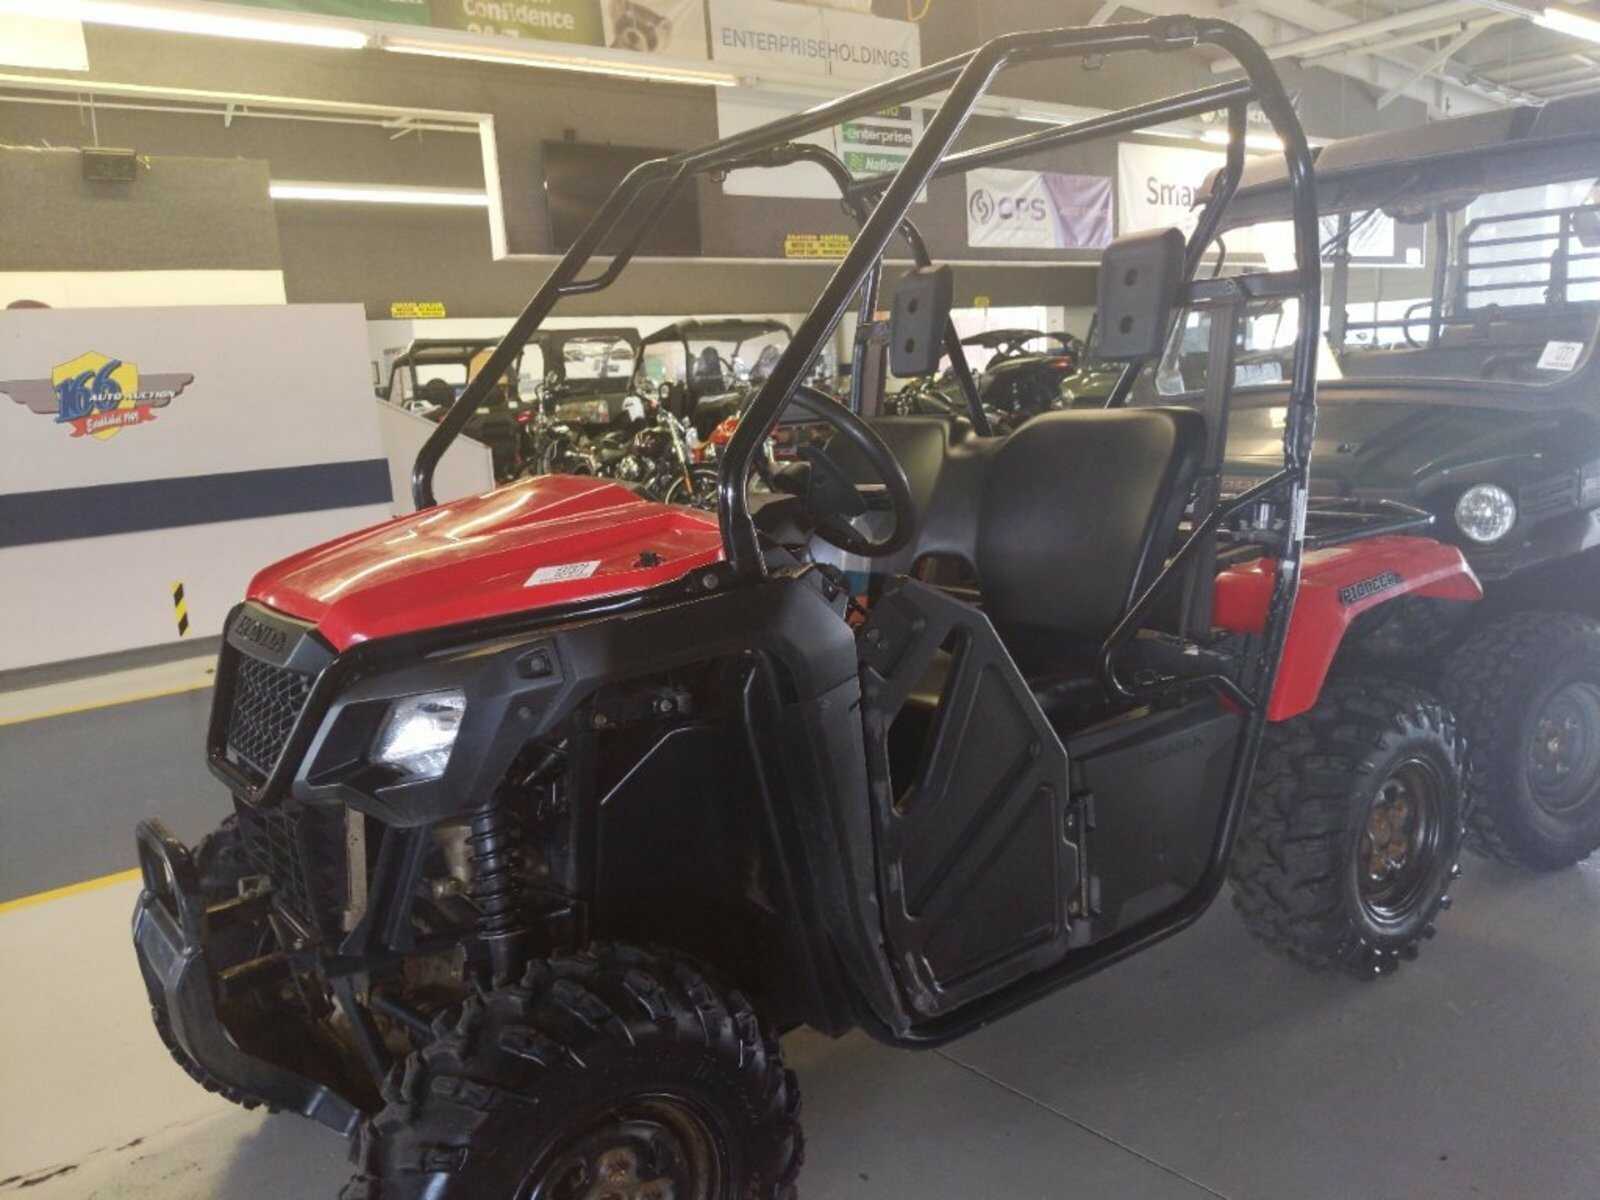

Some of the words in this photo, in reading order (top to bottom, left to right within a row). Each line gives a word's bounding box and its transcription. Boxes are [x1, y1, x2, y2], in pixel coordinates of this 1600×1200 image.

[462, 0, 576, 30] Confidence
[55, 359, 122, 424] 166
[89, 390, 122, 402] AUTO
[236, 615, 287, 653] HONDA
